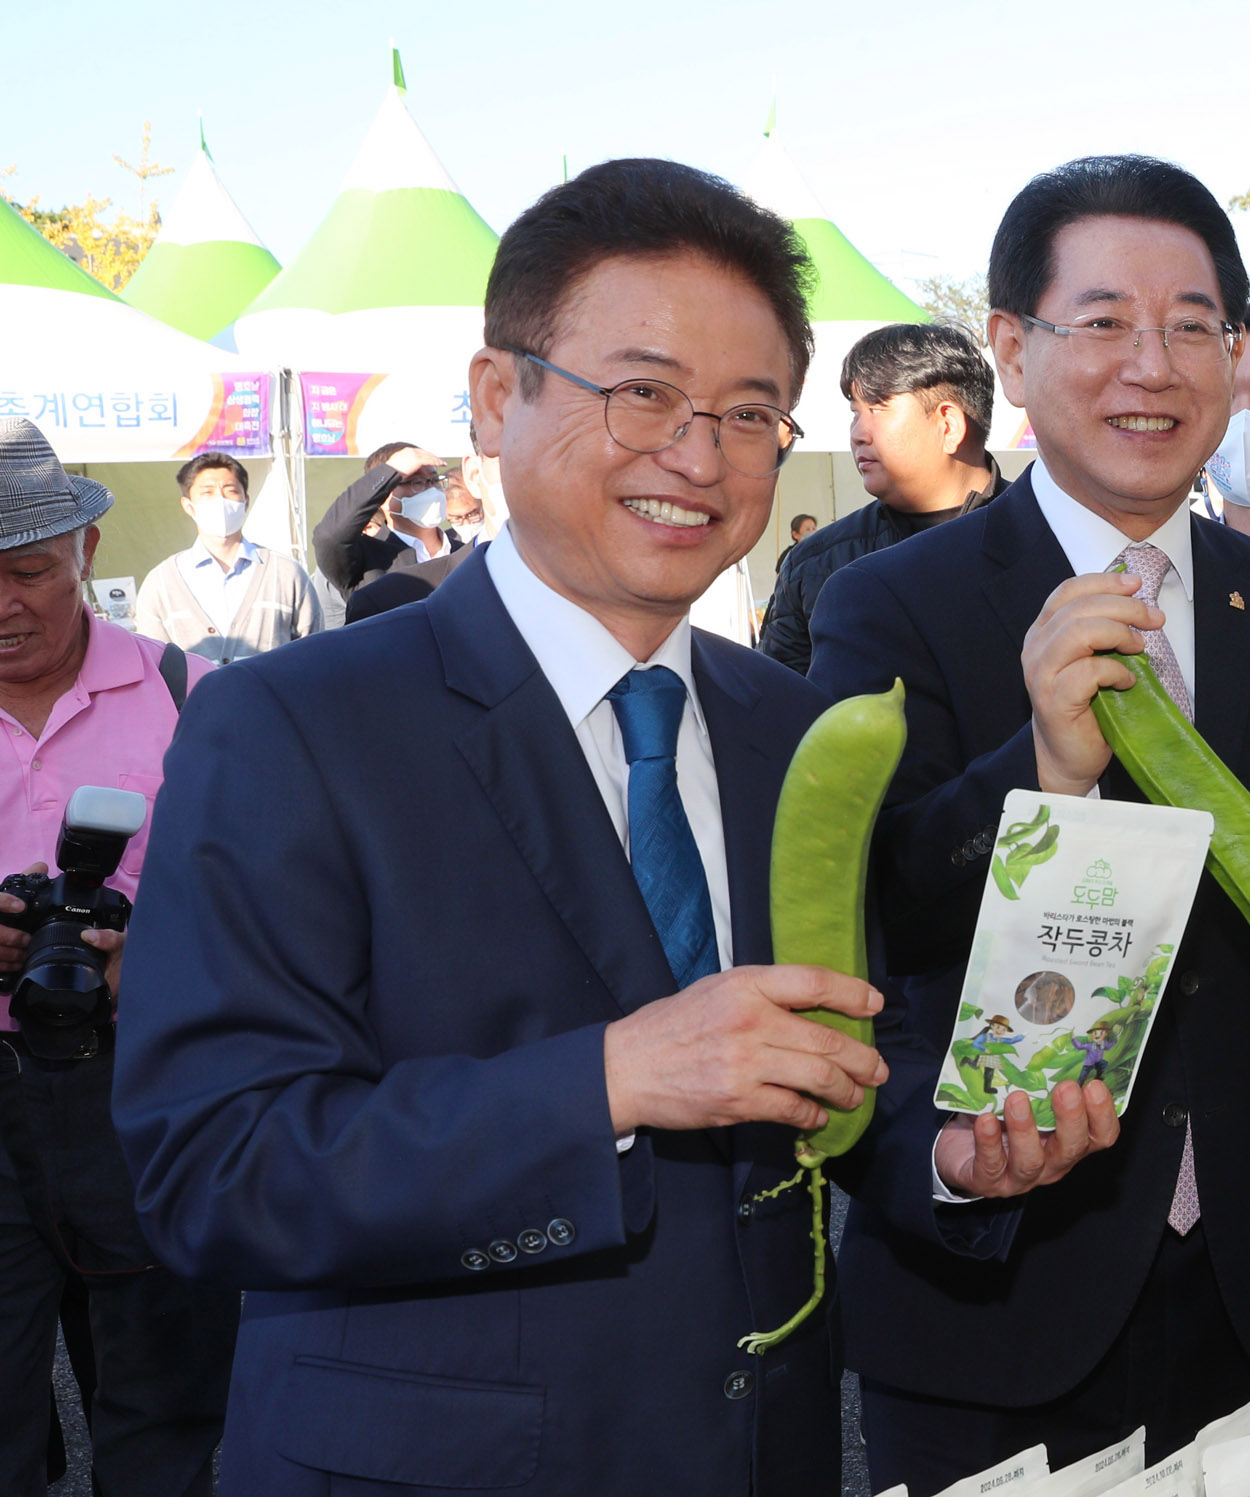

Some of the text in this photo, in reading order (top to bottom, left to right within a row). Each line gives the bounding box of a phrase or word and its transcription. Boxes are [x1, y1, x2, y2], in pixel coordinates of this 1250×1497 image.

[65, 905, 91, 914] Canon
[1070, 885, 1119, 910] 도두맘
[1037, 924, 1133, 958] 작두콩차
